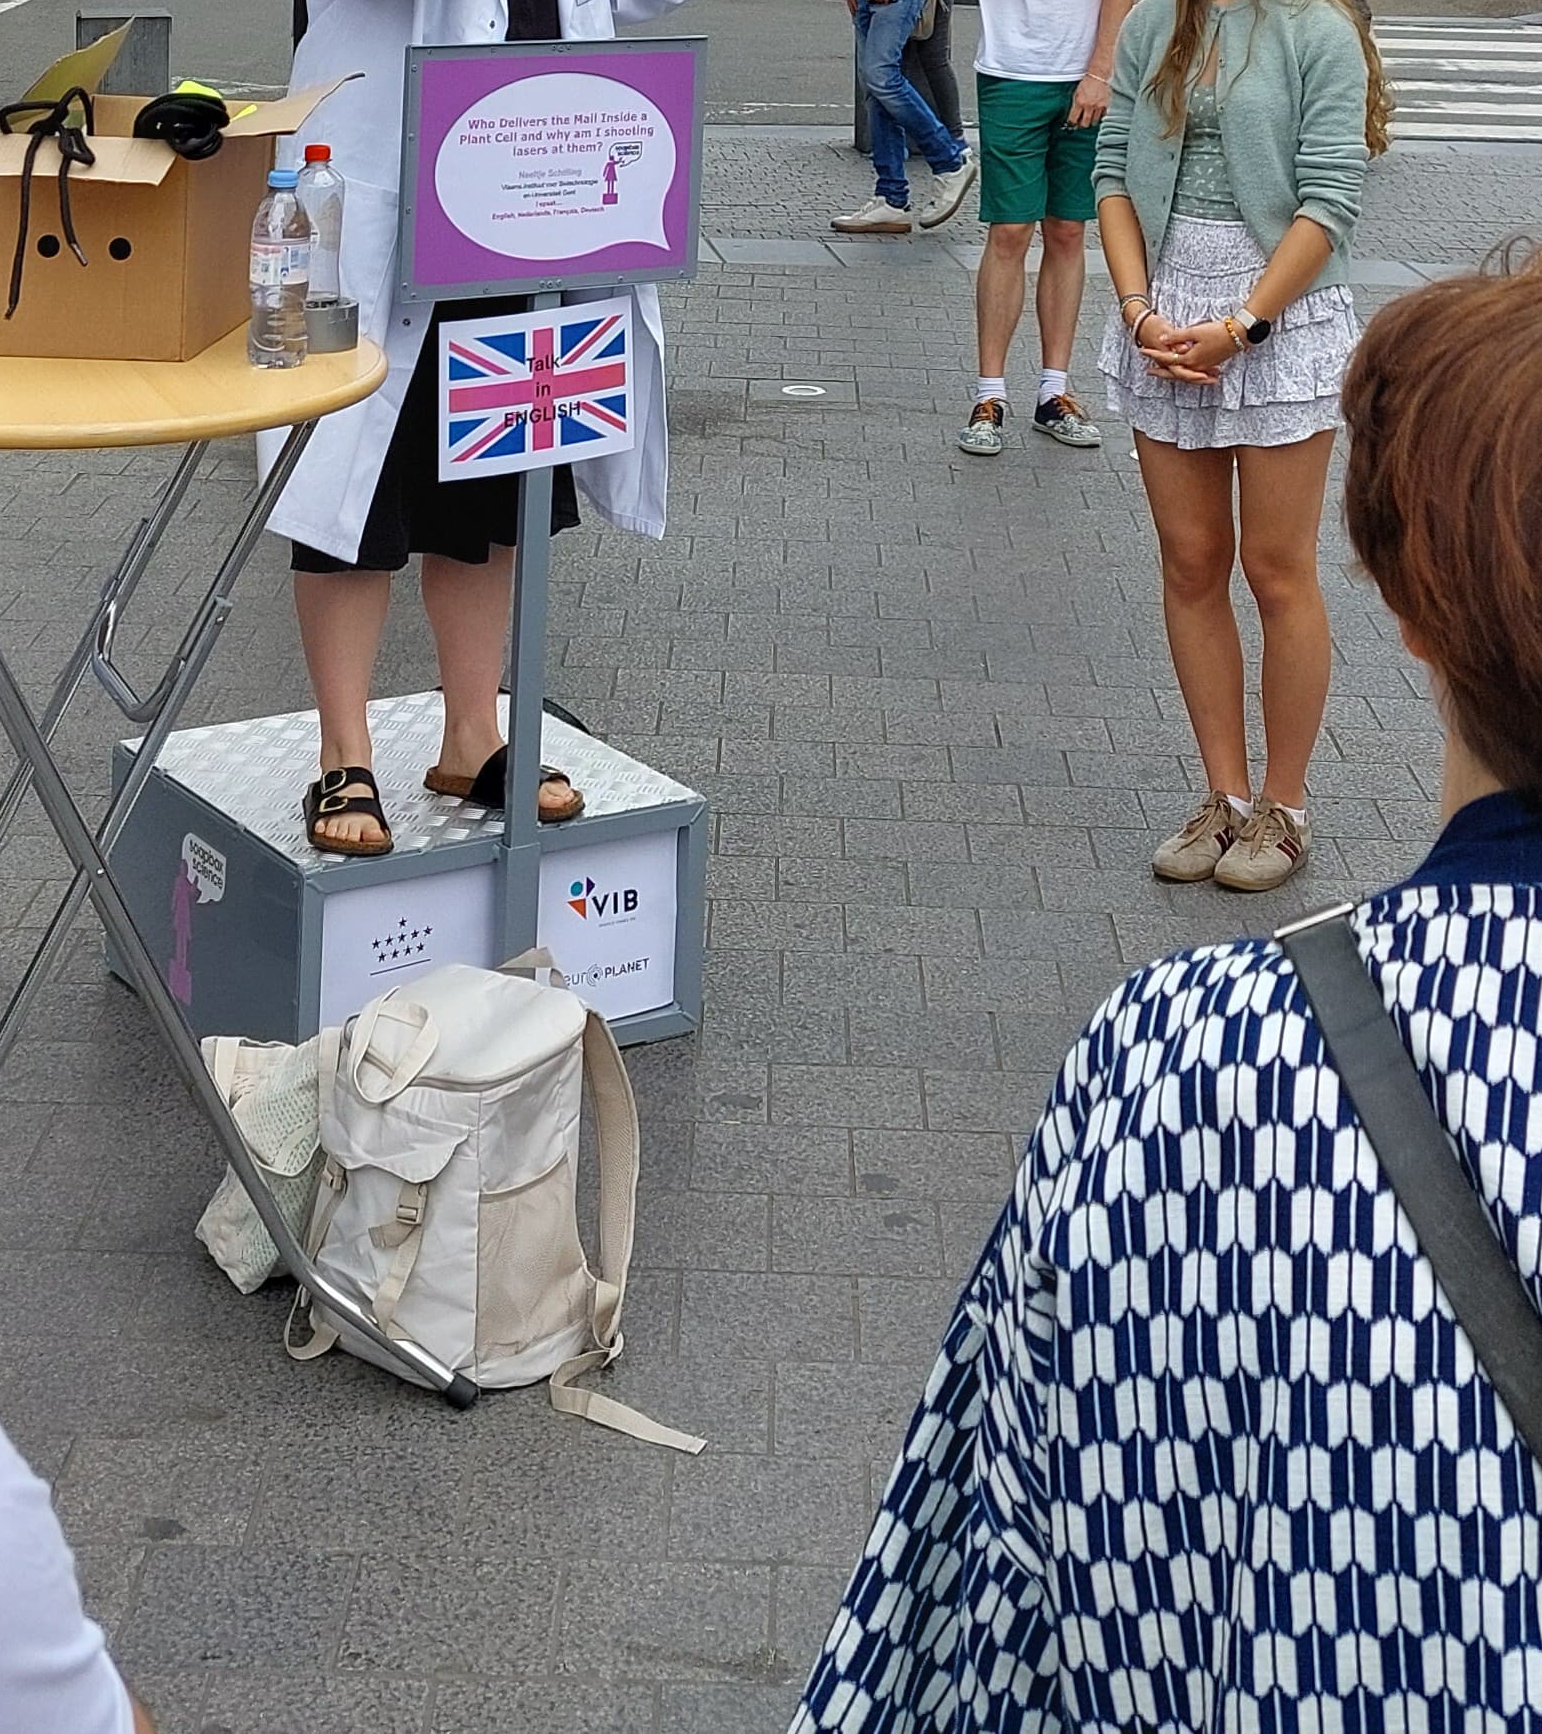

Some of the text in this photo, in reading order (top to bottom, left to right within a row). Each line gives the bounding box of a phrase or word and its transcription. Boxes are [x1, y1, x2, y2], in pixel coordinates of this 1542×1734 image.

[468, 112, 649, 130] Who Delivers the Mail Inside a
[459, 133, 492, 146] Plant
[495, 132, 518, 143] Cell
[520, 130, 544, 142] and
[546, 130, 571, 142] why
[574, 129, 592, 139] am
[604, 125, 655, 139] shooting
[512, 141, 603, 158] lasers at them?
[526, 354, 561, 373] Talk
[536, 381, 551, 398] in
[504, 400, 581, 429] ENGLISH
[189, 839, 224, 874] soapbox
[192, 857, 224, 891] science
[591, 888, 639, 918] VIB
